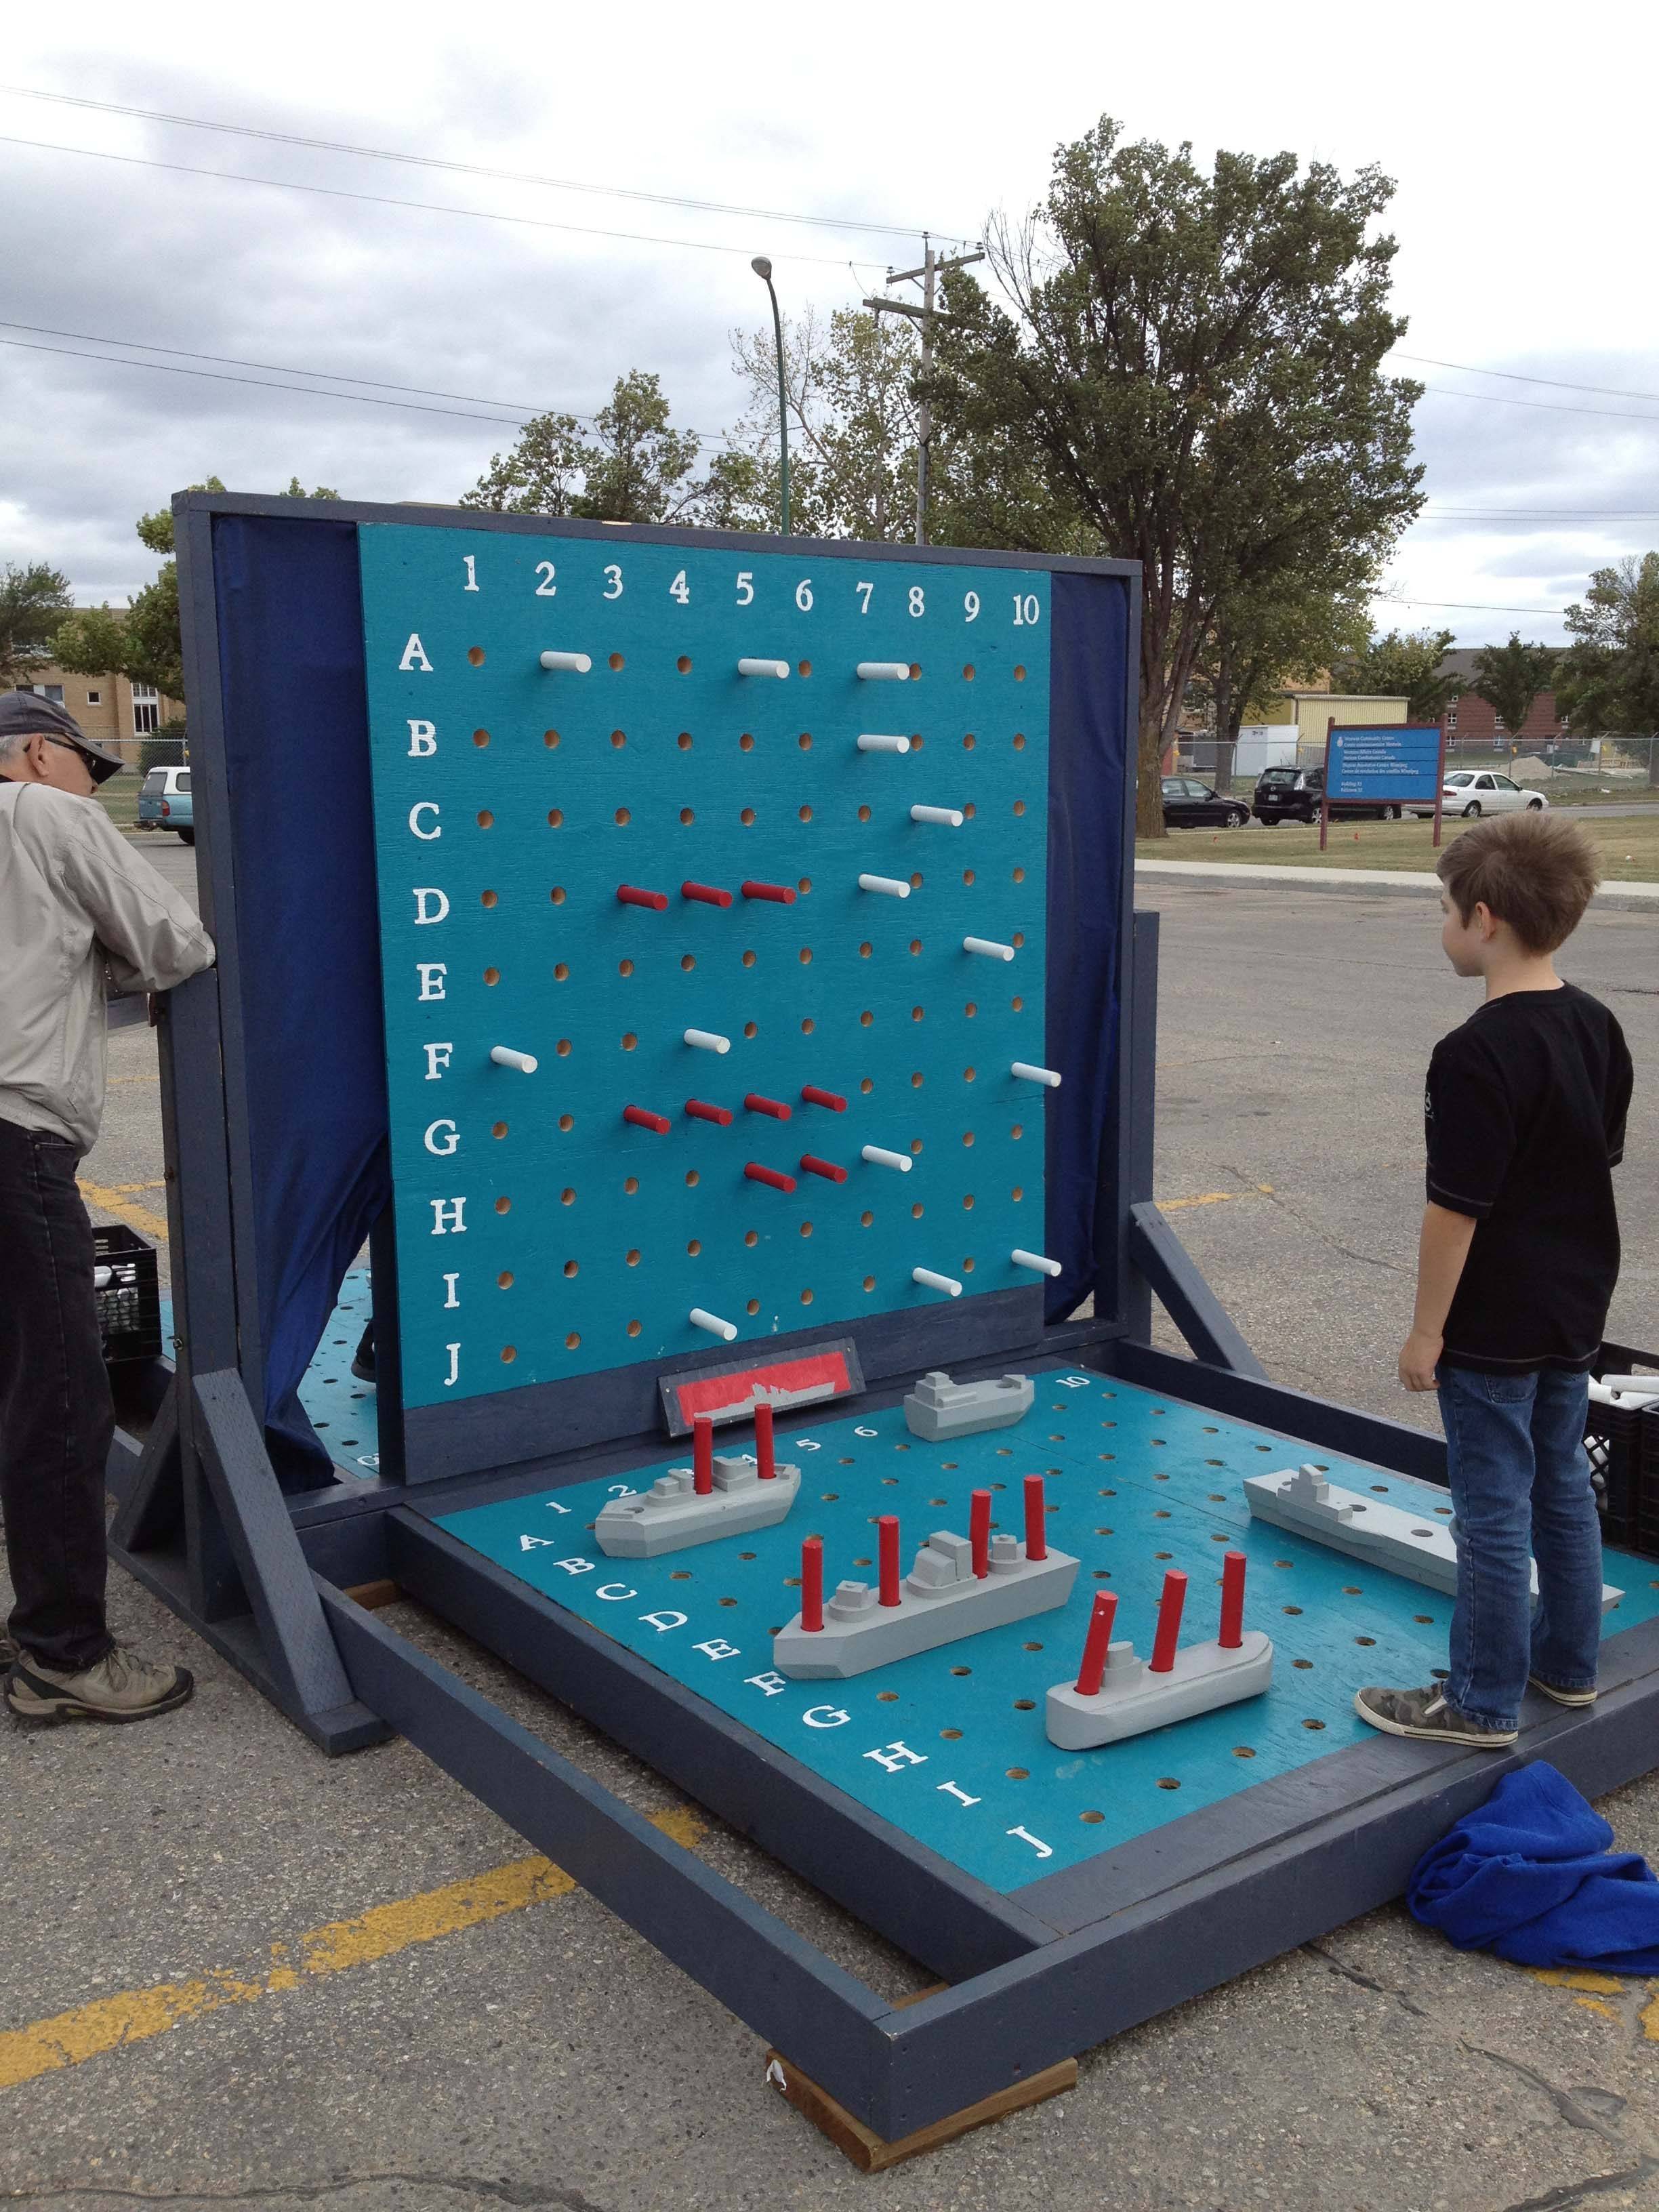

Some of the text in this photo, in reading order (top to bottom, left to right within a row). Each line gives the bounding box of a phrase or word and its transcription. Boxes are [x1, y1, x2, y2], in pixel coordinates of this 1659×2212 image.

[463, 554, 1040, 626] 1 2 3 4 5 6 7 8 9 10
[398, 633, 434, 672] A
[407, 719, 437, 757] B
[409, 802, 442, 840] C
[412, 888, 450, 924] D
[416, 963, 447, 1001] E
[423, 1042, 453, 1080] F
[424, 1119, 460, 1155] G
[430, 1197, 468, 1235] H
[443, 1272, 460, 1309] I
[444, 1343, 461, 1386] J
[546, 1376, 1090, 1514] 1 2 5 6 10
[520, 1534, 554, 1551] A
[552, 1557, 596, 1575] B
[596, 1582, 638, 1601] C
[638, 1611, 688, 1632] D
[692, 1638, 741, 1661] E
[743, 1671, 786, 1696] F
[802, 1705, 851, 1728] G
[862, 1740, 928, 1773] H
[936, 1780, 982, 1807] I
[1006, 1825, 1052, 1858] J
